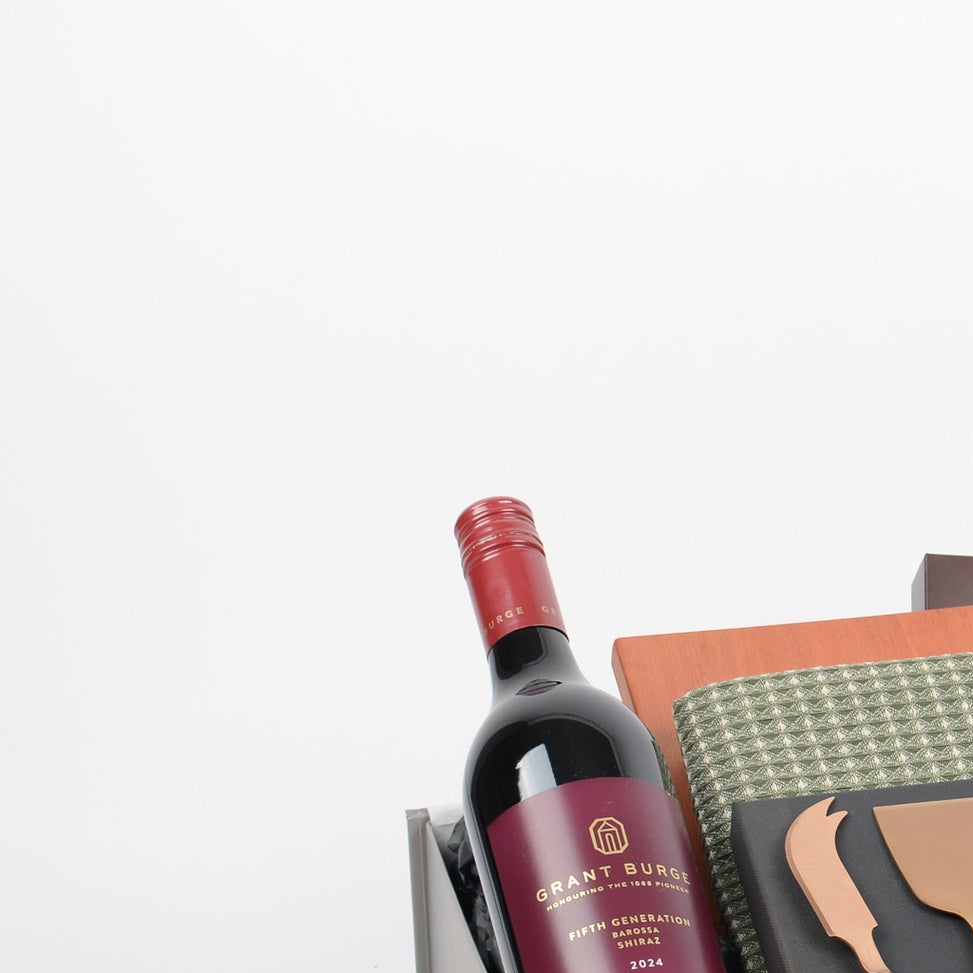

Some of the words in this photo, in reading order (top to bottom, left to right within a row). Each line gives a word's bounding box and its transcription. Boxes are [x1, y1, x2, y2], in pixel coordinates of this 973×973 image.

[536, 865, 612, 902] GRANT
[624, 862, 691, 885] BURGE
[546, 886, 605, 912] HONOURING
[608, 881, 628, 889] THE
[568, 921, 607, 942] FIFTH
[611, 914, 691, 927] GENERATION
[612, 926, 660, 939] BAROSSA
[617, 937, 661, 949] SHIRAZ
[630, 958, 664, 970] 2024
